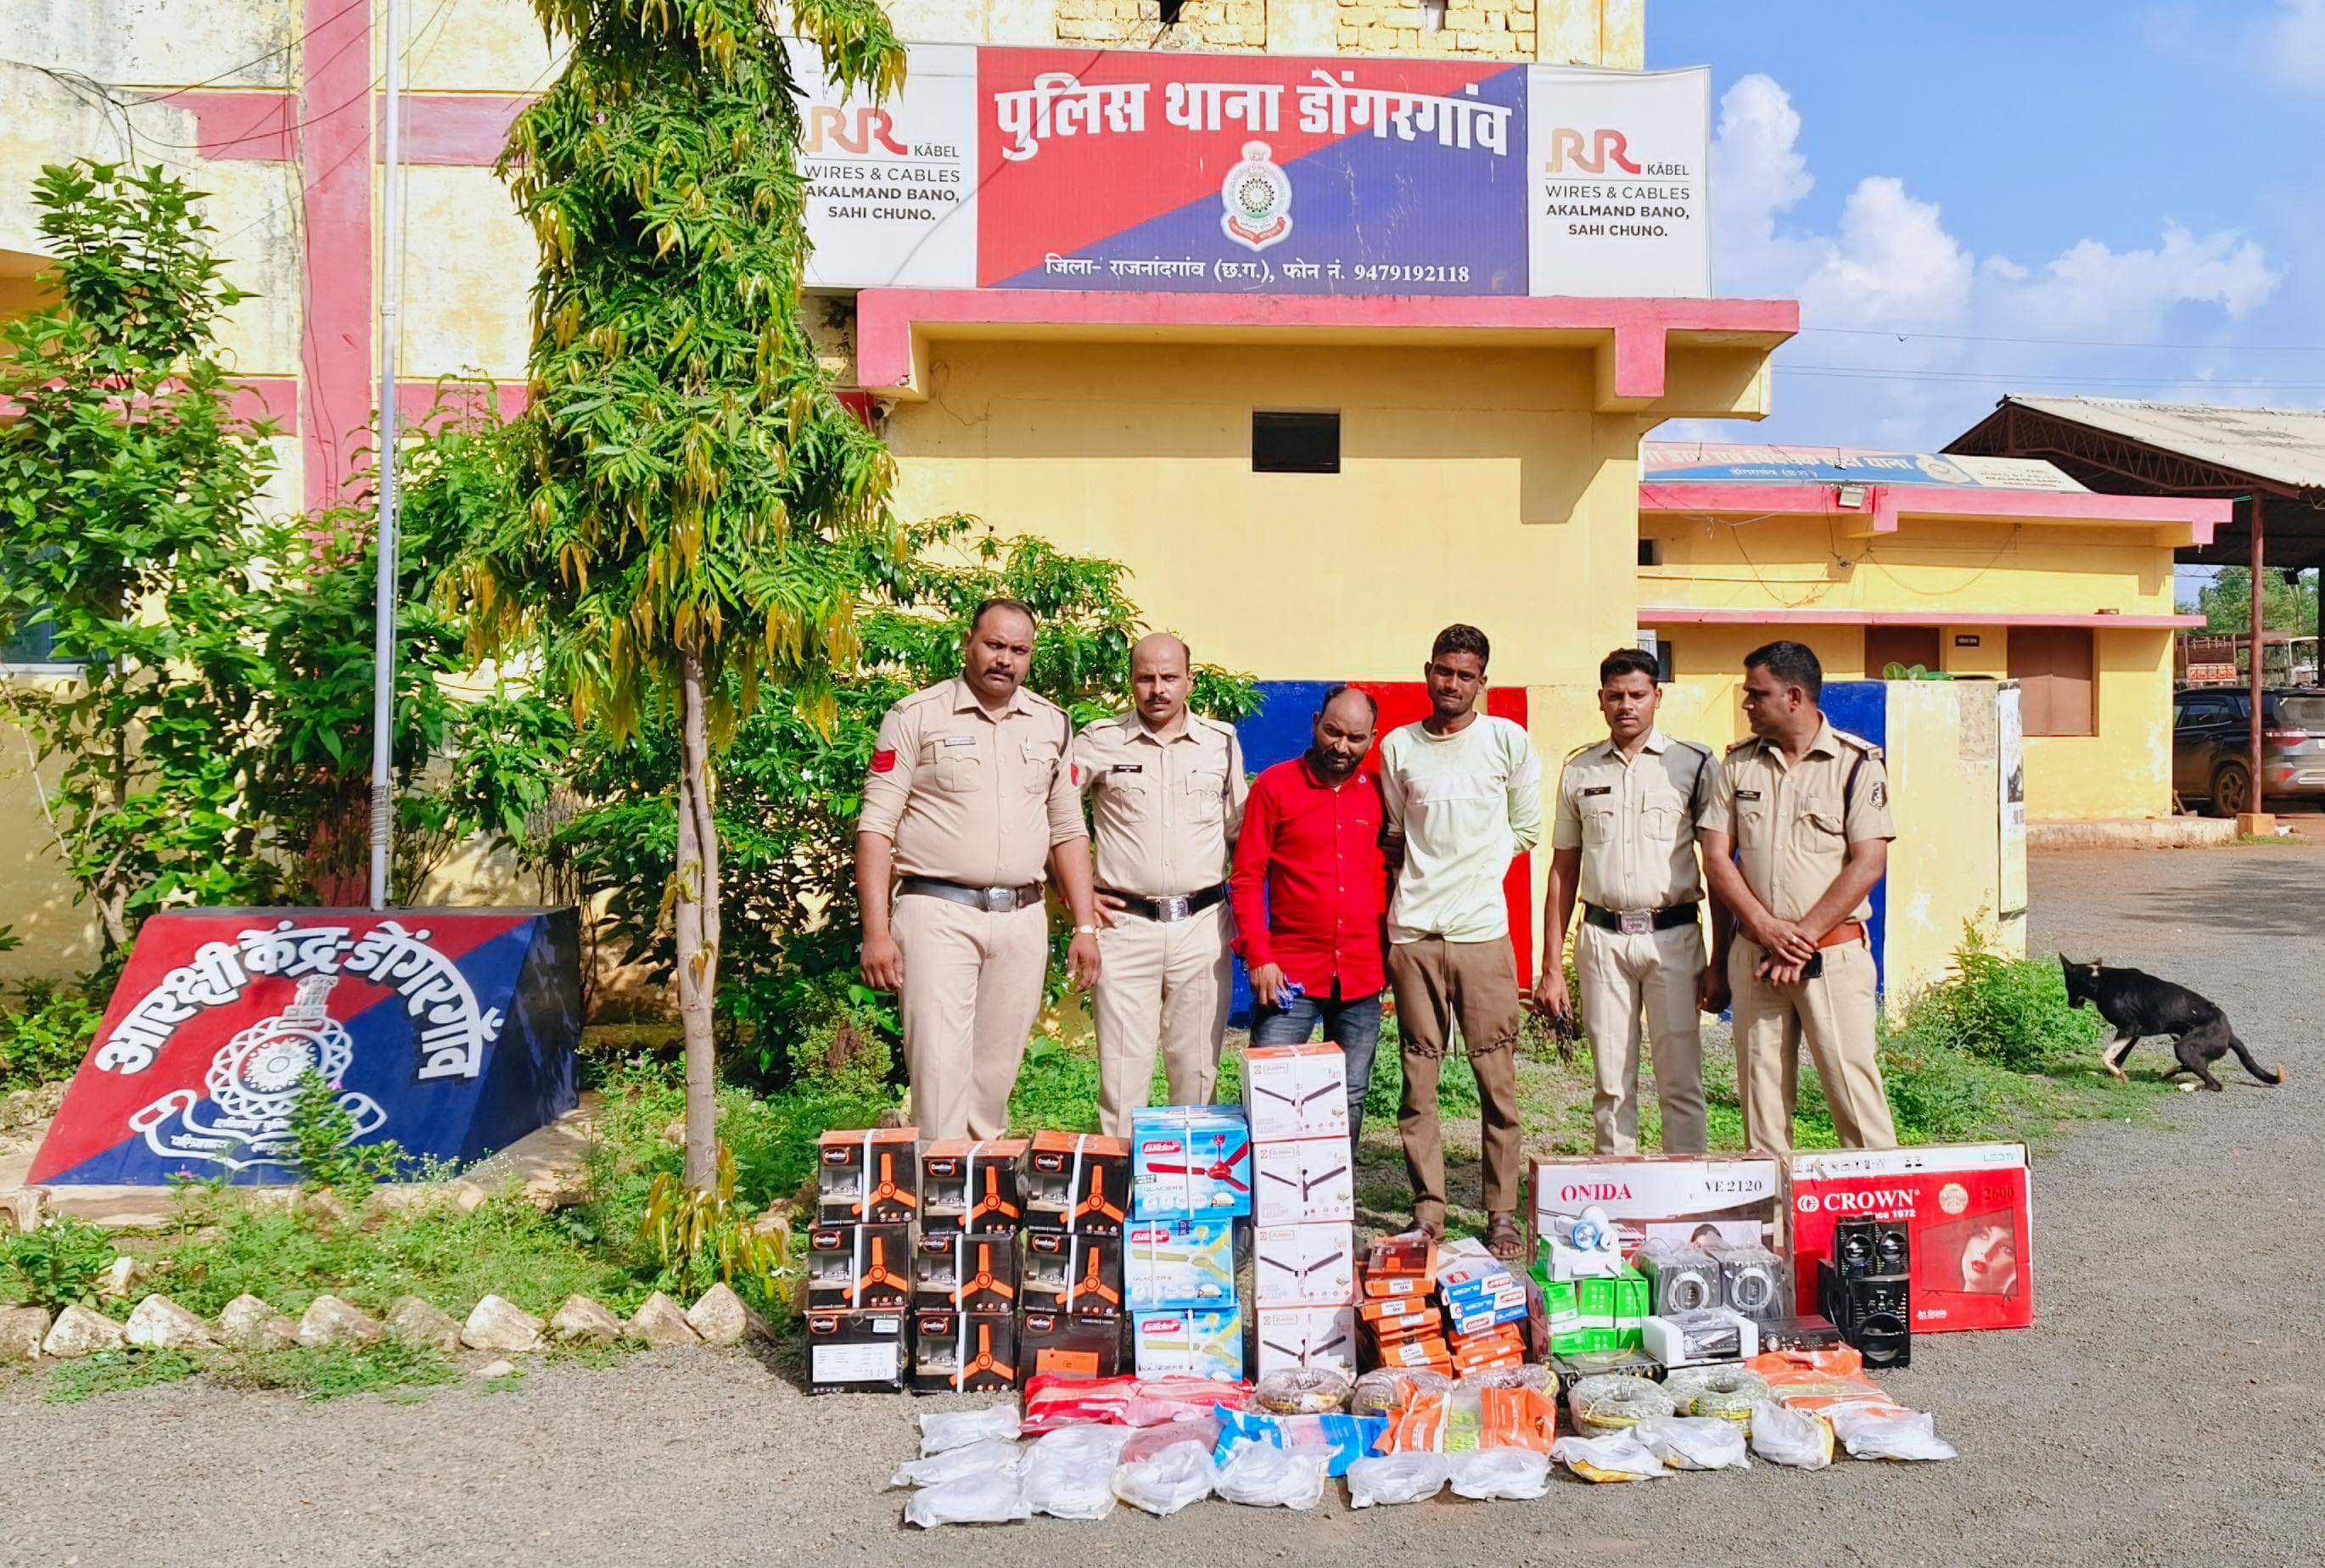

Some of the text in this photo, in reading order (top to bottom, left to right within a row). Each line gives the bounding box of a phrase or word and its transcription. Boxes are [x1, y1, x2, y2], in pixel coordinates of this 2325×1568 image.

[994, 70, 1513, 161] पुलिस थाना डोंगरगांव
[1545, 128, 1642, 175] RR
[804, 165, 961, 182] WIRES & CABLES
[806, 185, 960, 204] AKALMAND BANO,
[1545, 185, 1689, 200] WIRES & CABLES
[828, 206, 936, 221] SAHI CHUNO.
[1546, 204, 1689, 220] AKALMAND BANO,
[1568, 224, 1668, 237] SAHI CHUNO.
[1109, 255, 1206, 277] राजनांदगांव
[1283, 258, 1319, 279] फोन
[1354, 264, 1470, 283] 9479192118
[95, 942, 249, 1075] आरक्षी
[1560, 1180, 1633, 1202] ONIDA
[1727, 1180, 1762, 1192] 2120
[1824, 1190, 1915, 1211] CROWN
